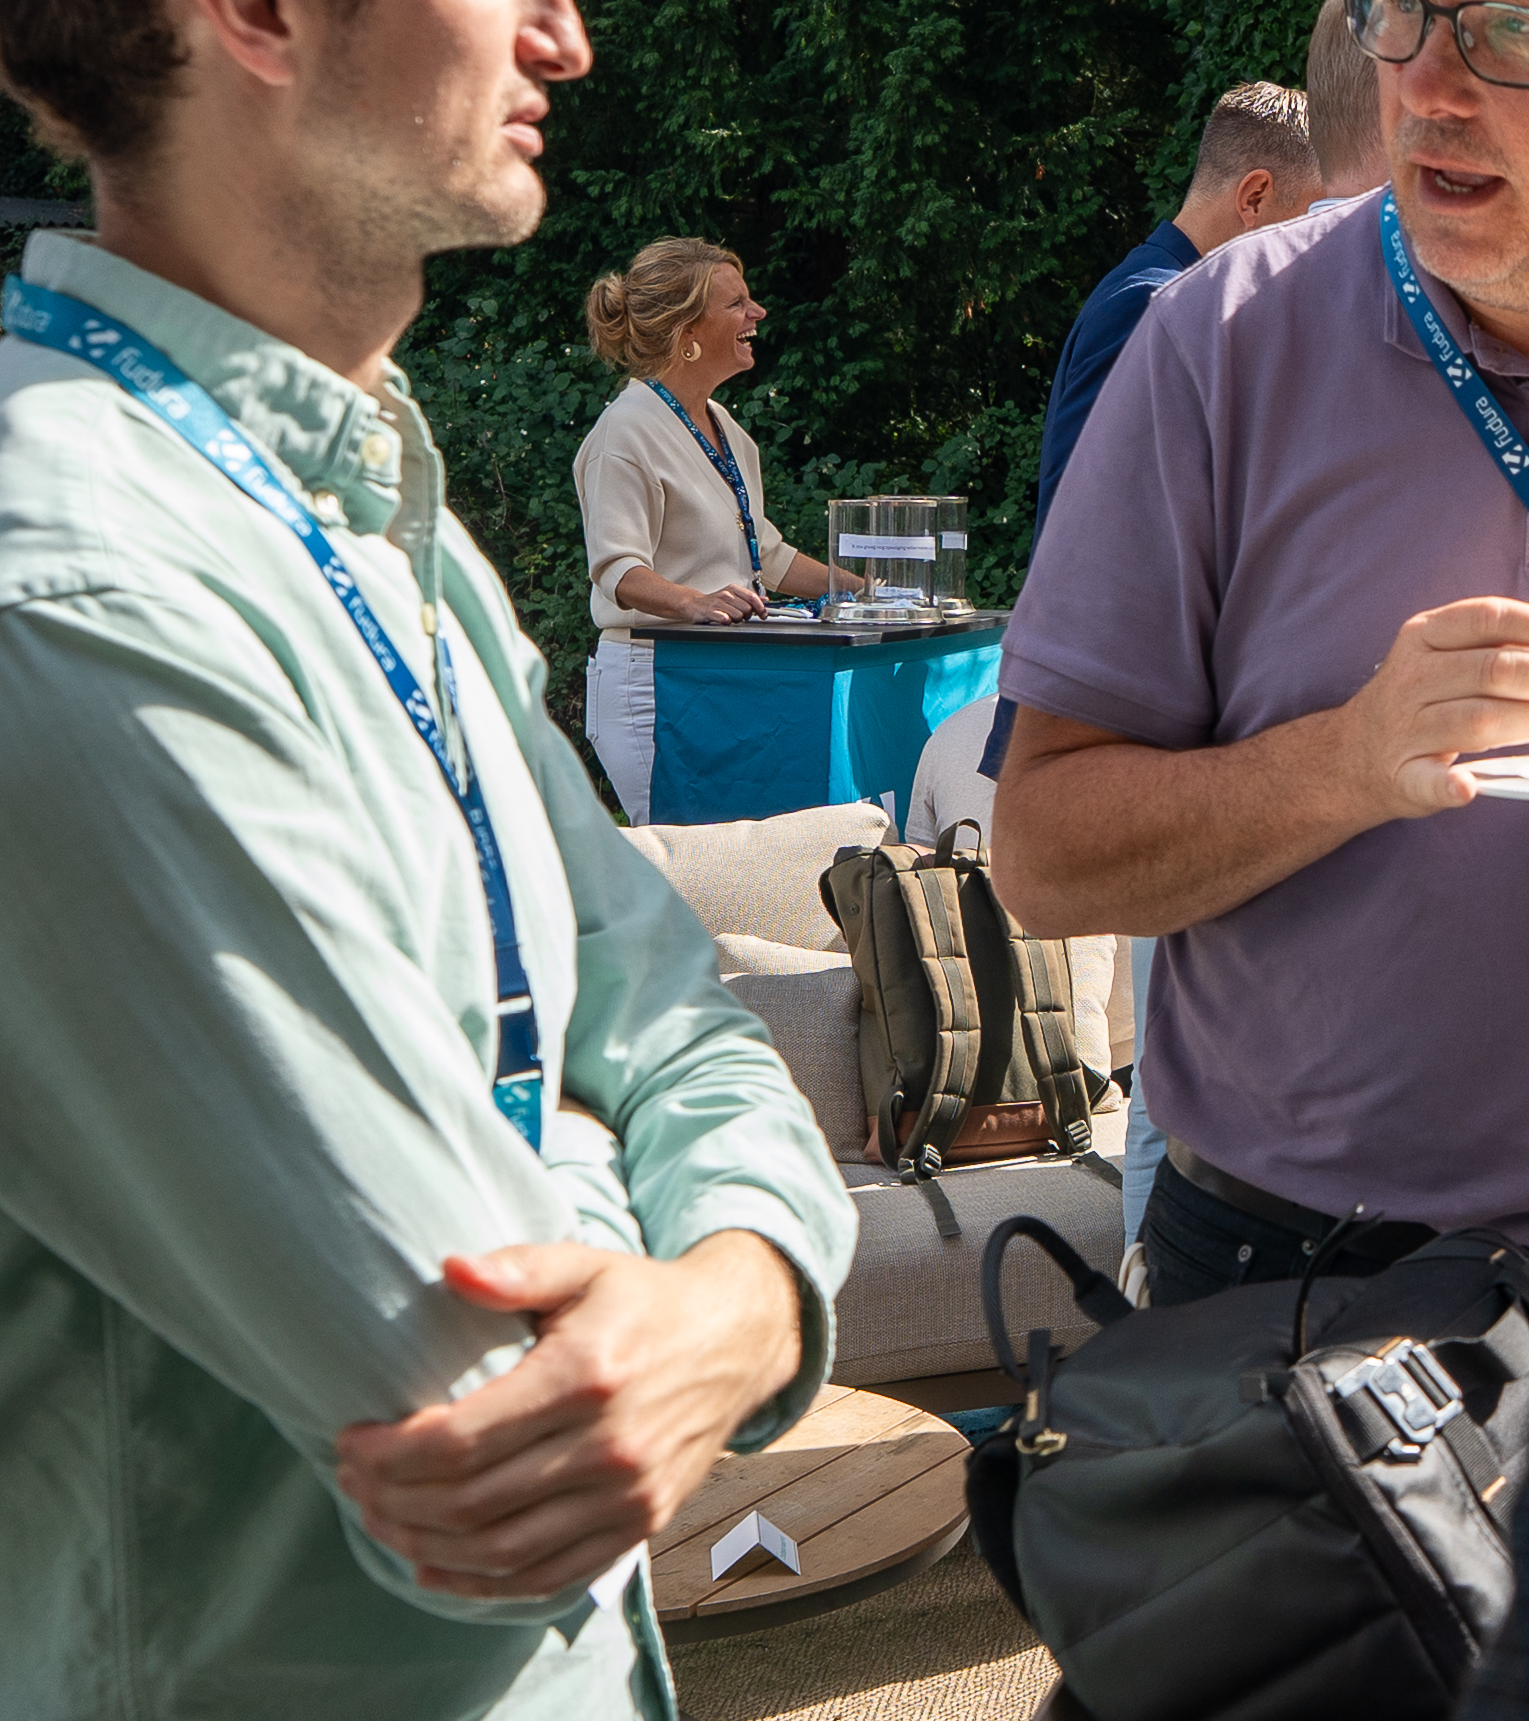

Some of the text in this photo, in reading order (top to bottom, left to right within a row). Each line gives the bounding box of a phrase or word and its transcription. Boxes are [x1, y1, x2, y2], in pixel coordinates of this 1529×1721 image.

[1390, 230, 1411, 279] fudura
[1423, 311, 1454, 362] fudura
[1475, 396, 1514, 449] fudura
